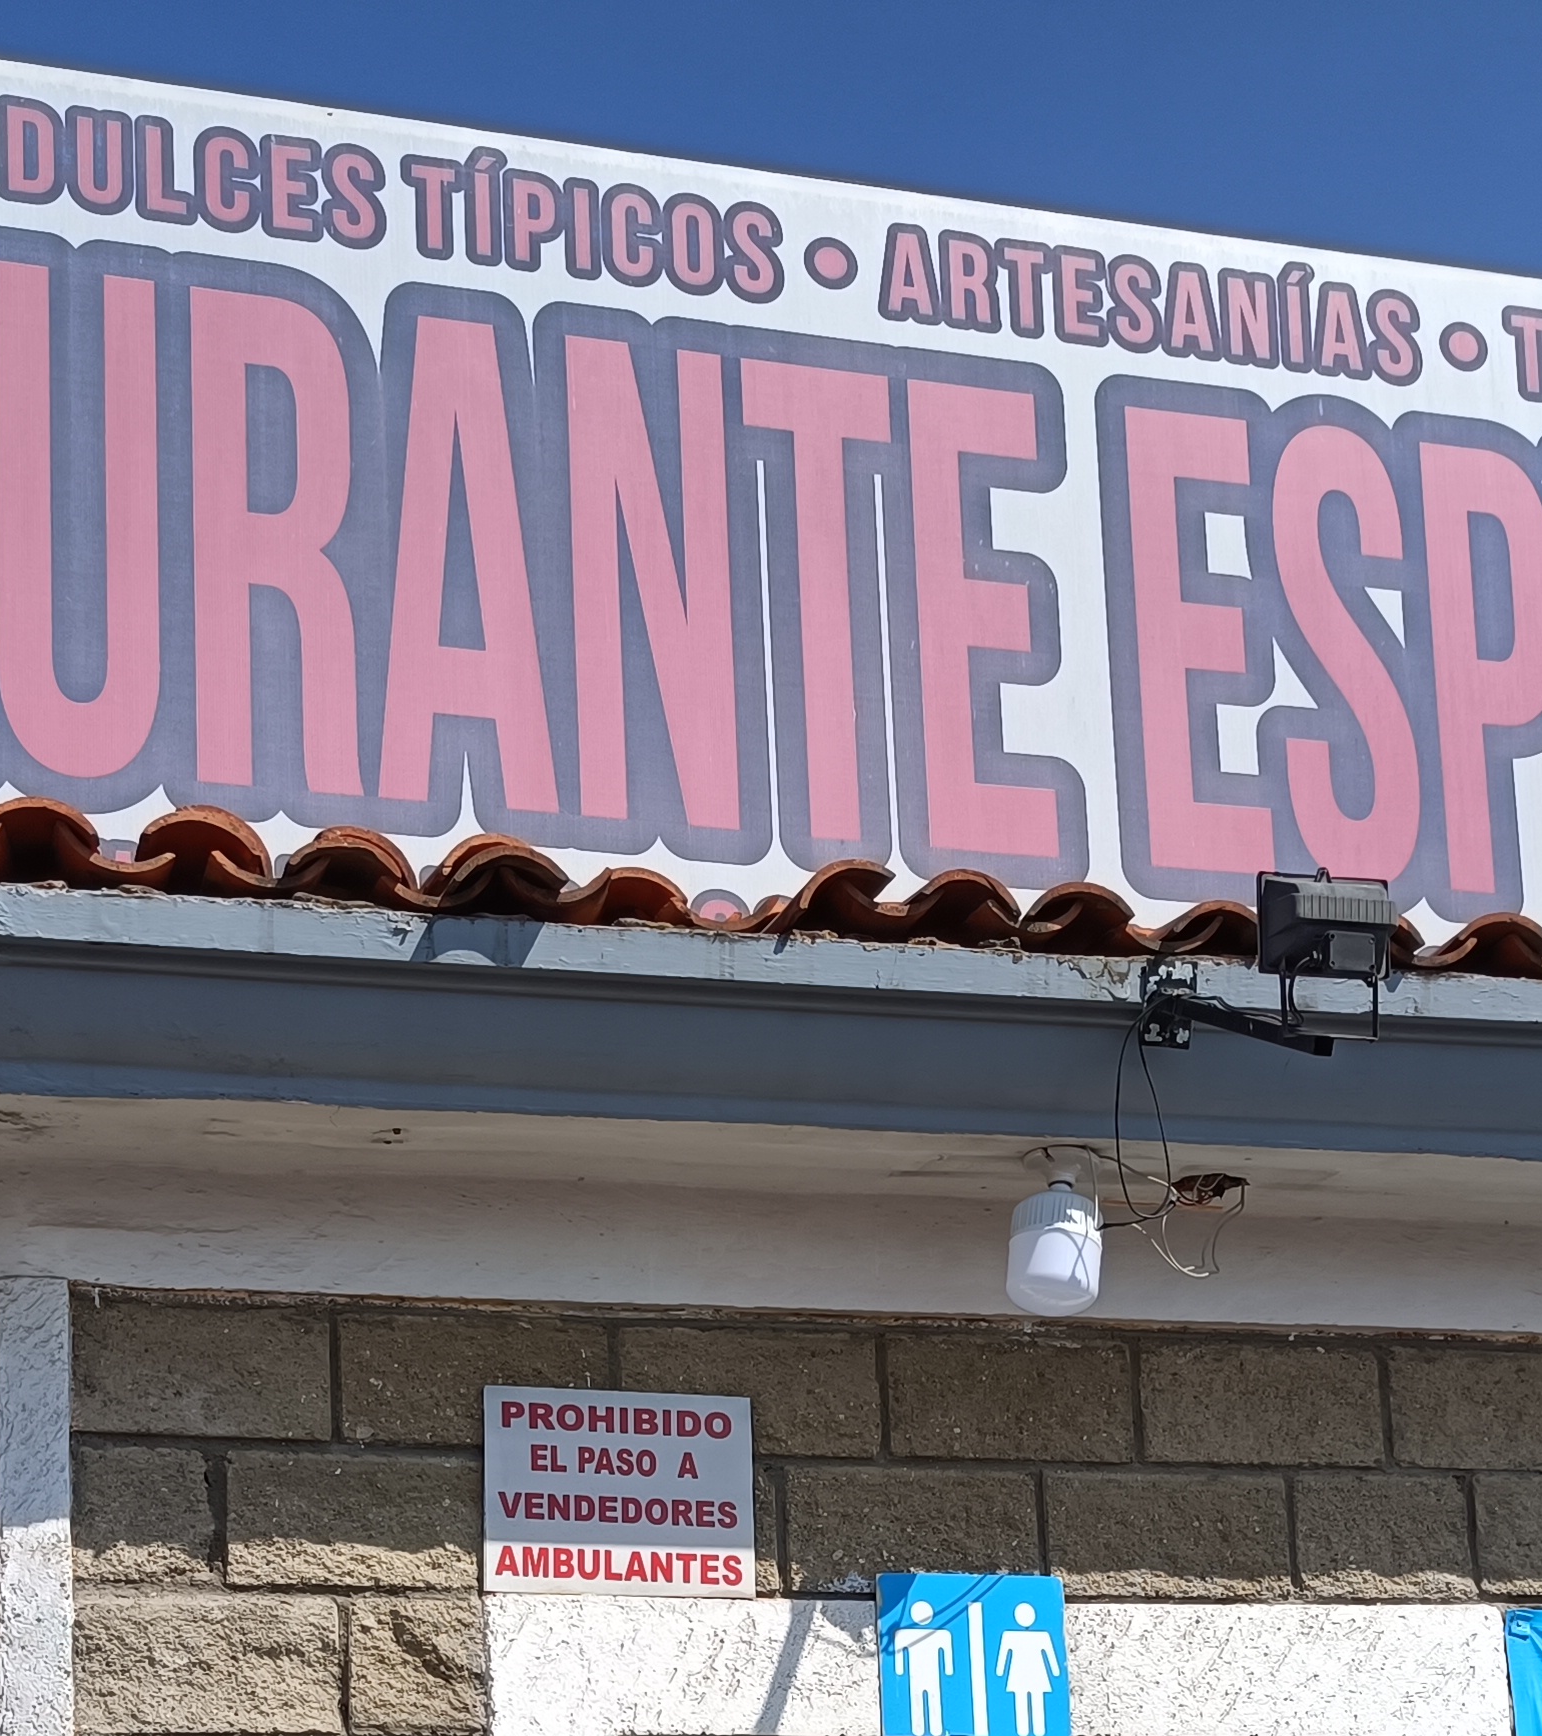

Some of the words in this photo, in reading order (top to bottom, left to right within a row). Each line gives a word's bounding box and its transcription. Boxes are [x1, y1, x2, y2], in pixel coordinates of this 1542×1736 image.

[400, 147, 784, 303] TÍPICOS
[879, 223, 1422, 386] ARTESANÍAS
[501, 1401, 732, 1439] PROHIBIDO
[530, 1444, 567, 1473] EL
[577, 1447, 658, 1478] PASO
[678, 1451, 698, 1480] A
[497, 1491, 739, 1530] VENDEDORES
[495, 1545, 743, 1587] AMBULANTES
